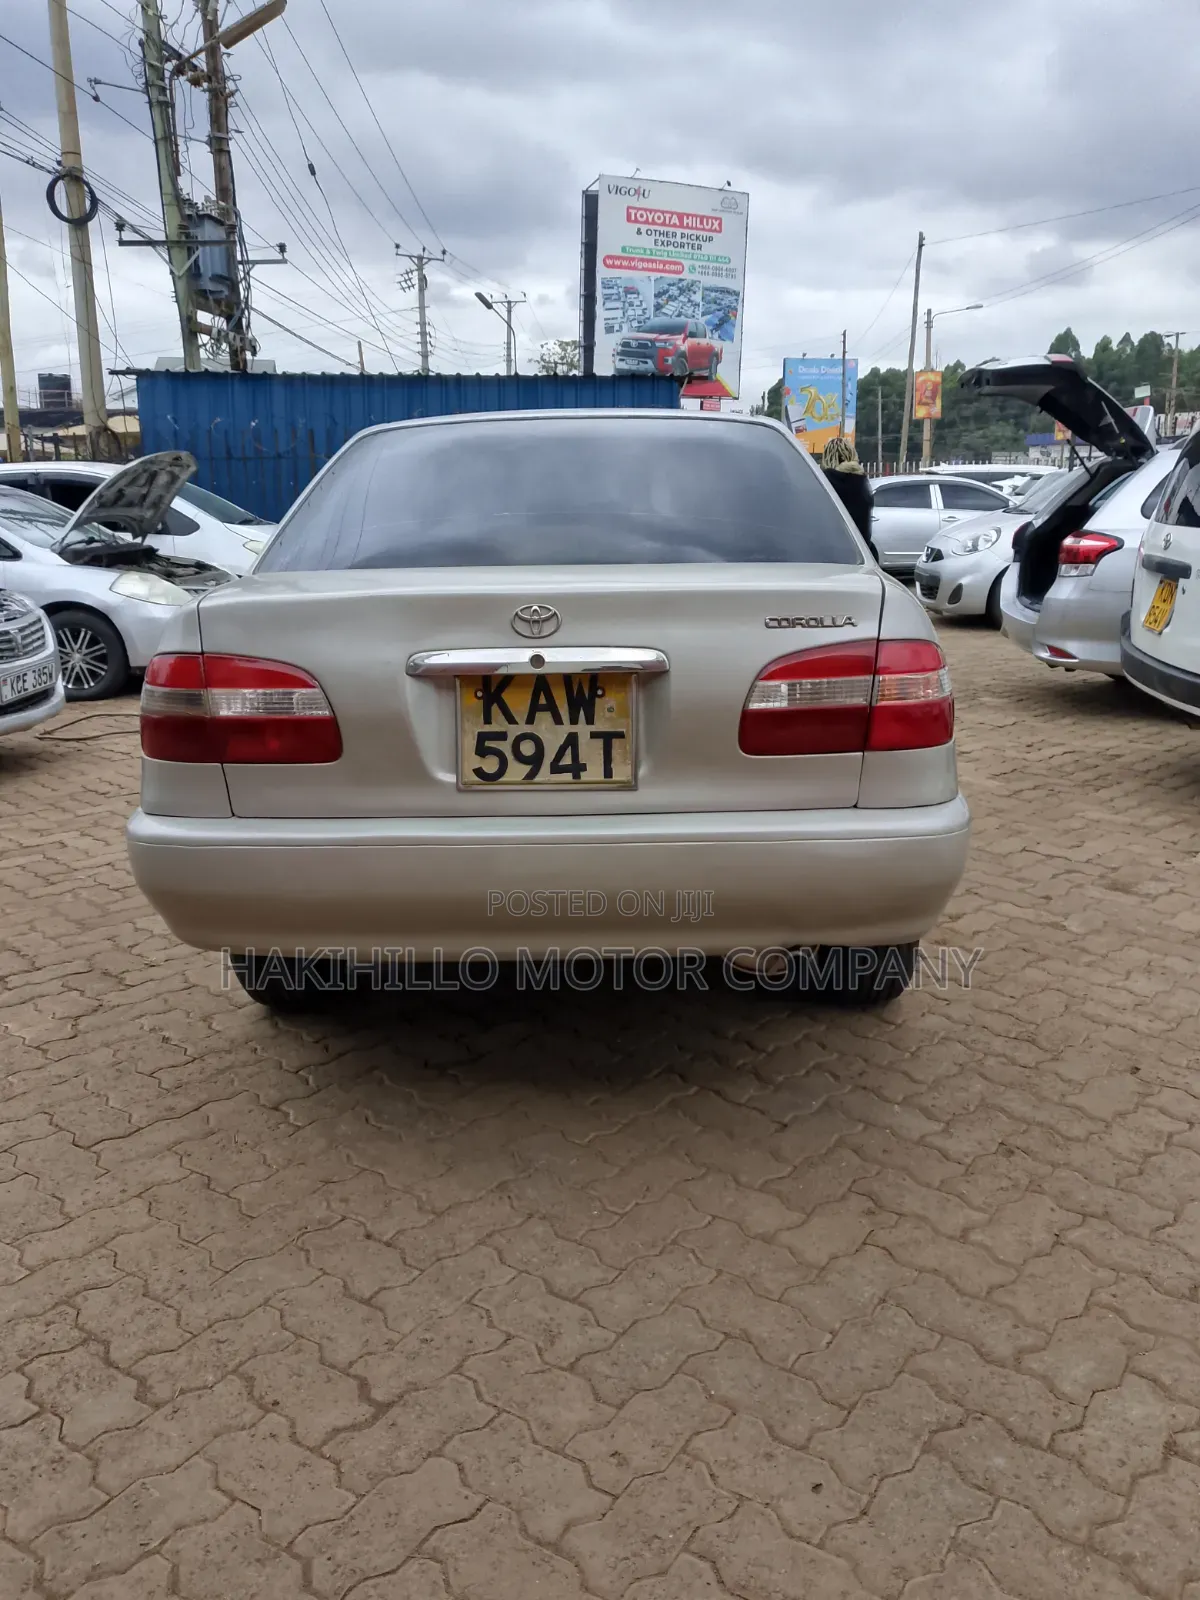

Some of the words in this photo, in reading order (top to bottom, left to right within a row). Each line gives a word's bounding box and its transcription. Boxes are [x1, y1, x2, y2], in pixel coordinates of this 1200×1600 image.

[628, 209, 680, 225] TOYOTA
[684, 217, 721, 231] HILUX
[636, 227, 642, 236] &
[646, 229, 678, 240] OTHER
[680, 233, 714, 243] PICKUP
[654, 239, 703, 251] EXPORTER
[606, 258, 682, 272] www.vigoasia.com
[765, 615, 858, 629] COROLLA
[10, 672, 28, 698] KCE
[32, 662, 54, 689] 385W
[482, 674, 598, 725] KAW
[472, 731, 626, 782] 594T
